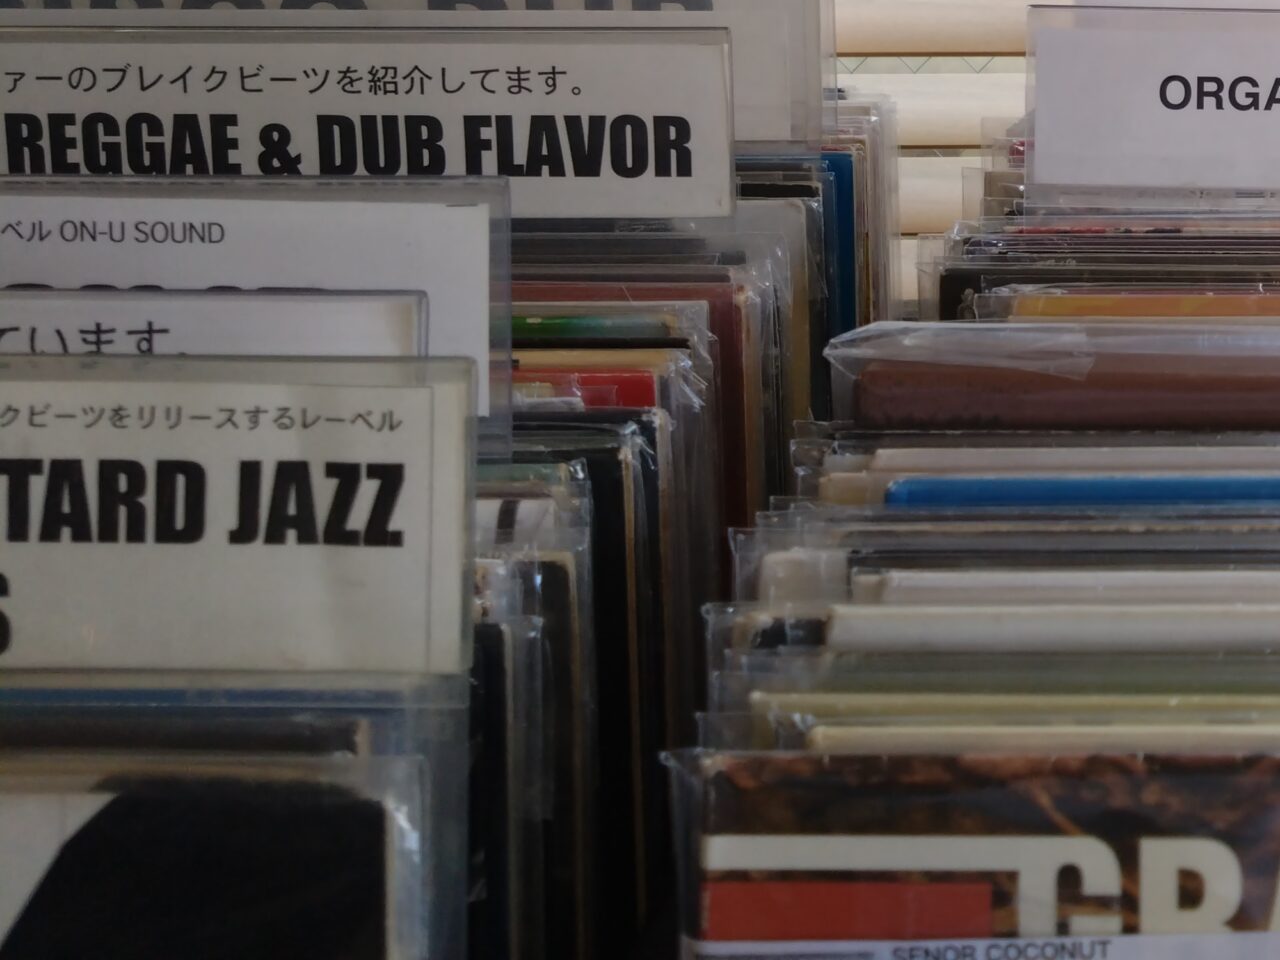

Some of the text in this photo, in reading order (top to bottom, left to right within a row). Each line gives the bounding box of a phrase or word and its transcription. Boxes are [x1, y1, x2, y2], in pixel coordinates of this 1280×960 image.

[3, 111, 693, 179] REGGAE & DUB FLAVOR
[59, 219, 126, 243] ON-U
[134, 220, 225, 244] SOUND
[228, 459, 405, 548] JAZZ
[984, 941, 1111, 960] COCONUT
